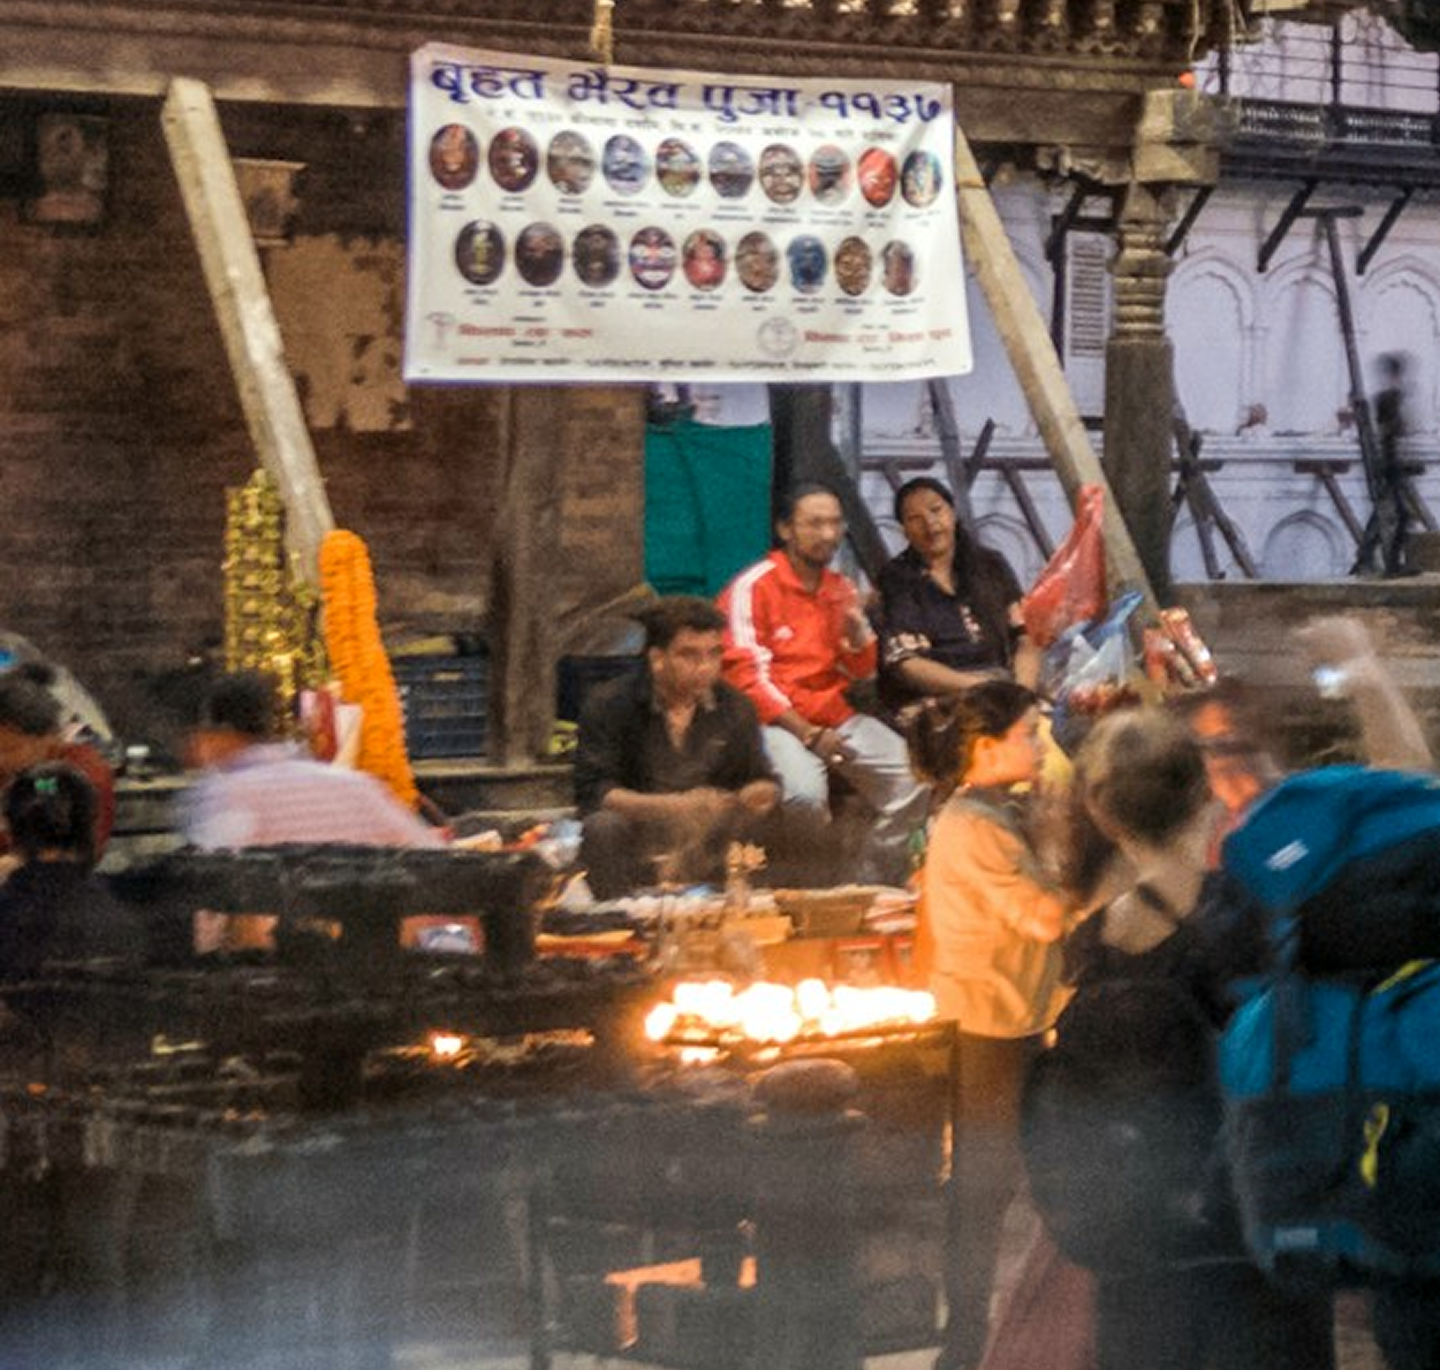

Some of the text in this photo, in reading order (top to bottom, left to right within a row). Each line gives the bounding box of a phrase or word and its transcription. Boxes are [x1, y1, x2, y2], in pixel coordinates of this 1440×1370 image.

[431, 61, 549, 104] बृहत
[567, 67, 688, 110] भैरव
[818, 90, 941, 124] ११३७
